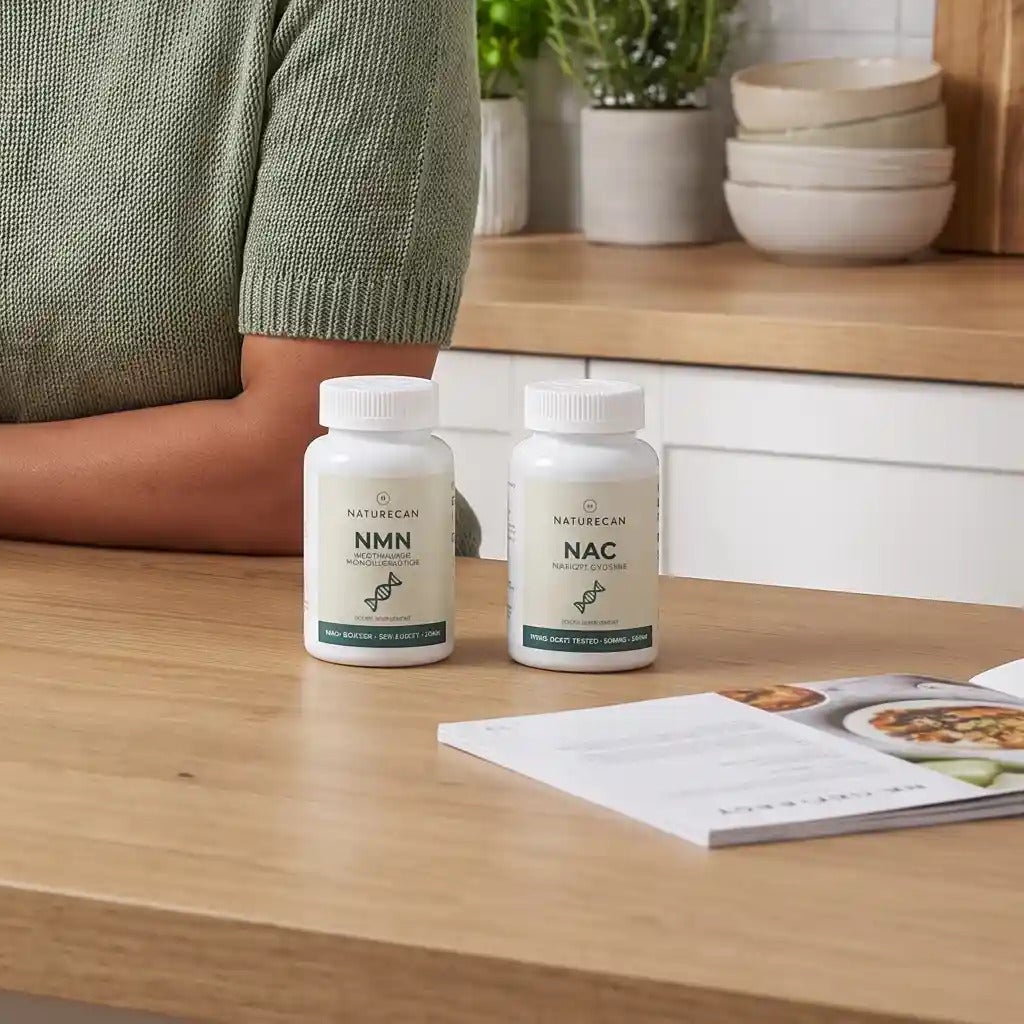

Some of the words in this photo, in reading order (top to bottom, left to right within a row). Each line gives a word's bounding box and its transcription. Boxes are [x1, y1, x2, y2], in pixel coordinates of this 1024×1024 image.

[347, 508, 419, 519] NATURECAN
[553, 516, 626, 526] NATURECAN
[355, 531, 411, 550] NMN
[564, 541, 617, 560] NAC
